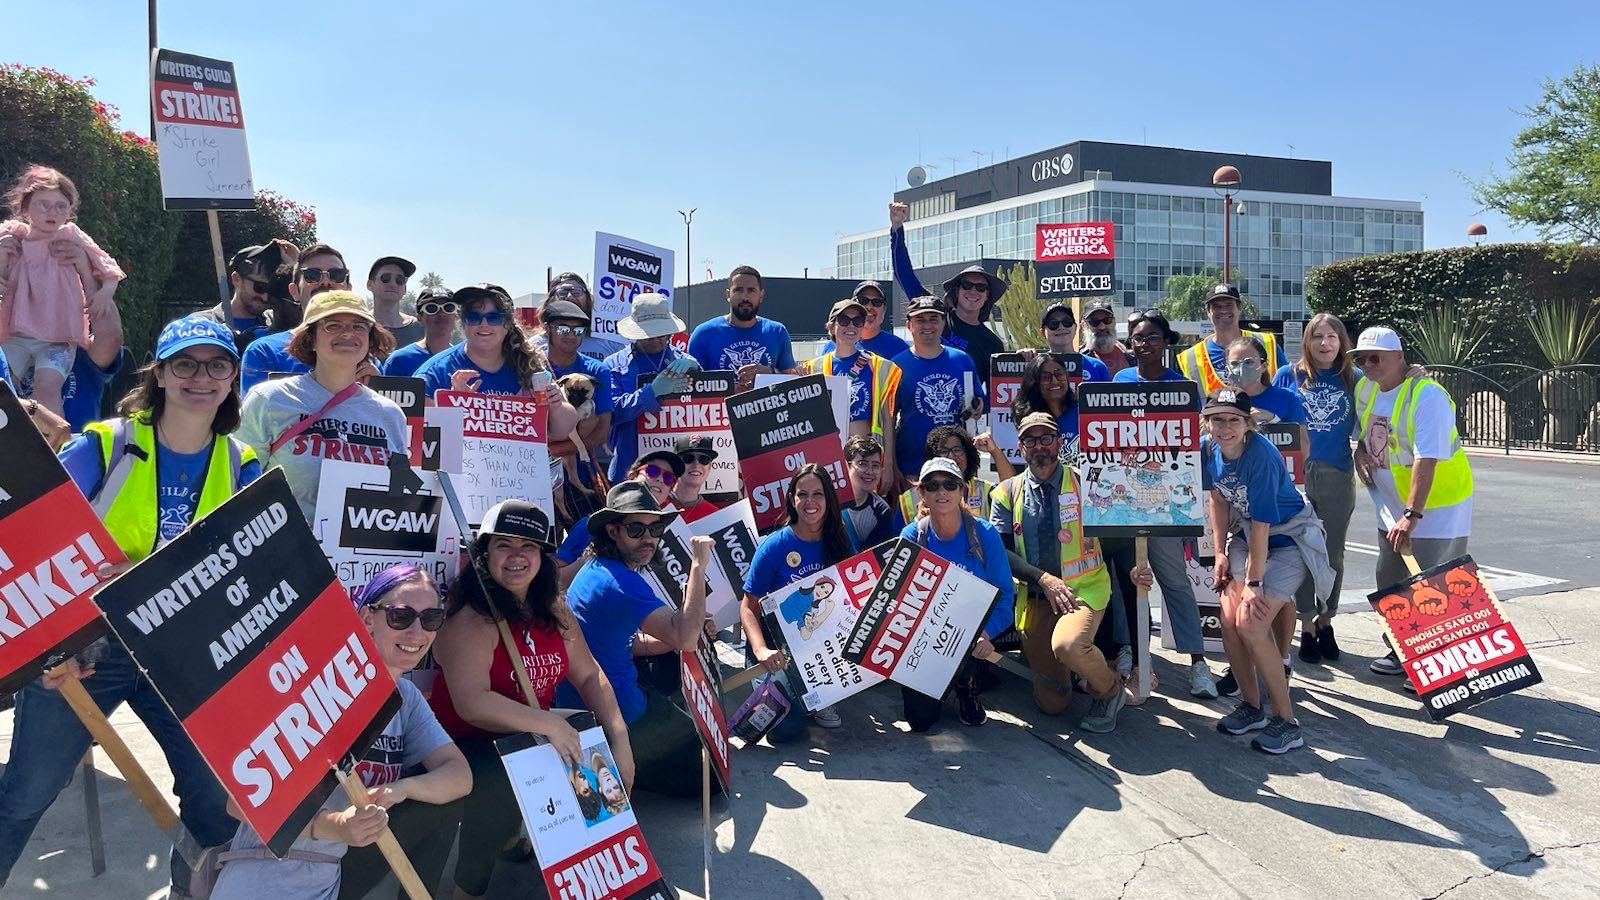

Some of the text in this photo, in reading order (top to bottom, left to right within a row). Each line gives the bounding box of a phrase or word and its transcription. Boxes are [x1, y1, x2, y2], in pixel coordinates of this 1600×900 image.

[160, 60, 232, 84] WRITERS GUILD
[194, 82, 204, 91] ON
[161, 89, 238, 124] STRIKE!
[196, 151, 220, 168] Girl
[1032, 156, 1060, 182] CBS
[1042, 227, 1105, 238] WRITERS
[1045, 237, 1089, 248] GUILD
[1041, 245, 1109, 256] AMERICA
[610, 254, 660, 275] WGAW
[1065, 263, 1083, 274] ON
[1040, 275, 1111, 293] STRIKE
[696, 380, 728, 392] GUILD
[448, 395, 536, 414] WRITERS
[680, 395, 692, 403] ON
[732, 384, 822, 419] WRITERS GUILD
[1086, 392, 1190, 407] WRITERS GUILD
[514, 416, 532, 426] OF
[644, 402, 730, 430] STRIKE!
[777, 410, 788, 422] OF
[1132, 408, 1144, 418] ON
[352, 422, 386, 438] GUILD
[464, 420, 538, 438] MERICA
[760, 420, 814, 448] AMERICA
[1087, 419, 1192, 447] STRIKE!
[479, 441, 513, 458] ASKING
[518, 447, 536, 464] FOR
[784, 452, 806, 472] ON
[481, 457, 510, 472] THAN
[516, 462, 536, 478] ONE
[712, 462, 736, 470] ovies
[491, 478, 524, 490] NEWS
[348, 506, 437, 534] WGAW
[126, 502, 288, 636] WRITERS GUILD
[226, 576, 250, 607] OF
[848, 592, 890, 654] WRITERS
[884, 547, 912, 590] GUILD
[871, 558, 942, 670] STRIKE!
[886, 599, 898, 614] ON
[208, 580, 300, 672] AMERICA
[906, 630, 932, 672] BEST
[934, 582, 959, 619] FINAL
[932, 616, 956, 656] NOT
[1404, 608, 1492, 646] 100 DAYS STRONG
[1416, 620, 1490, 654] 100 DAYS LONG
[268, 644, 309, 694] ON
[522, 652, 562, 668] RITERS
[824, 640, 850, 688] on dicks
[1412, 629, 1516, 687] STRIKE!
[804, 662, 823, 688] day!
[814, 653, 834, 688] every
[1465, 668, 1480, 680] ON
[1431, 664, 1532, 710] WRITERS GUILD
[232, 632, 377, 808] STRIKE!
[554, 836, 648, 900] STRIKE!
